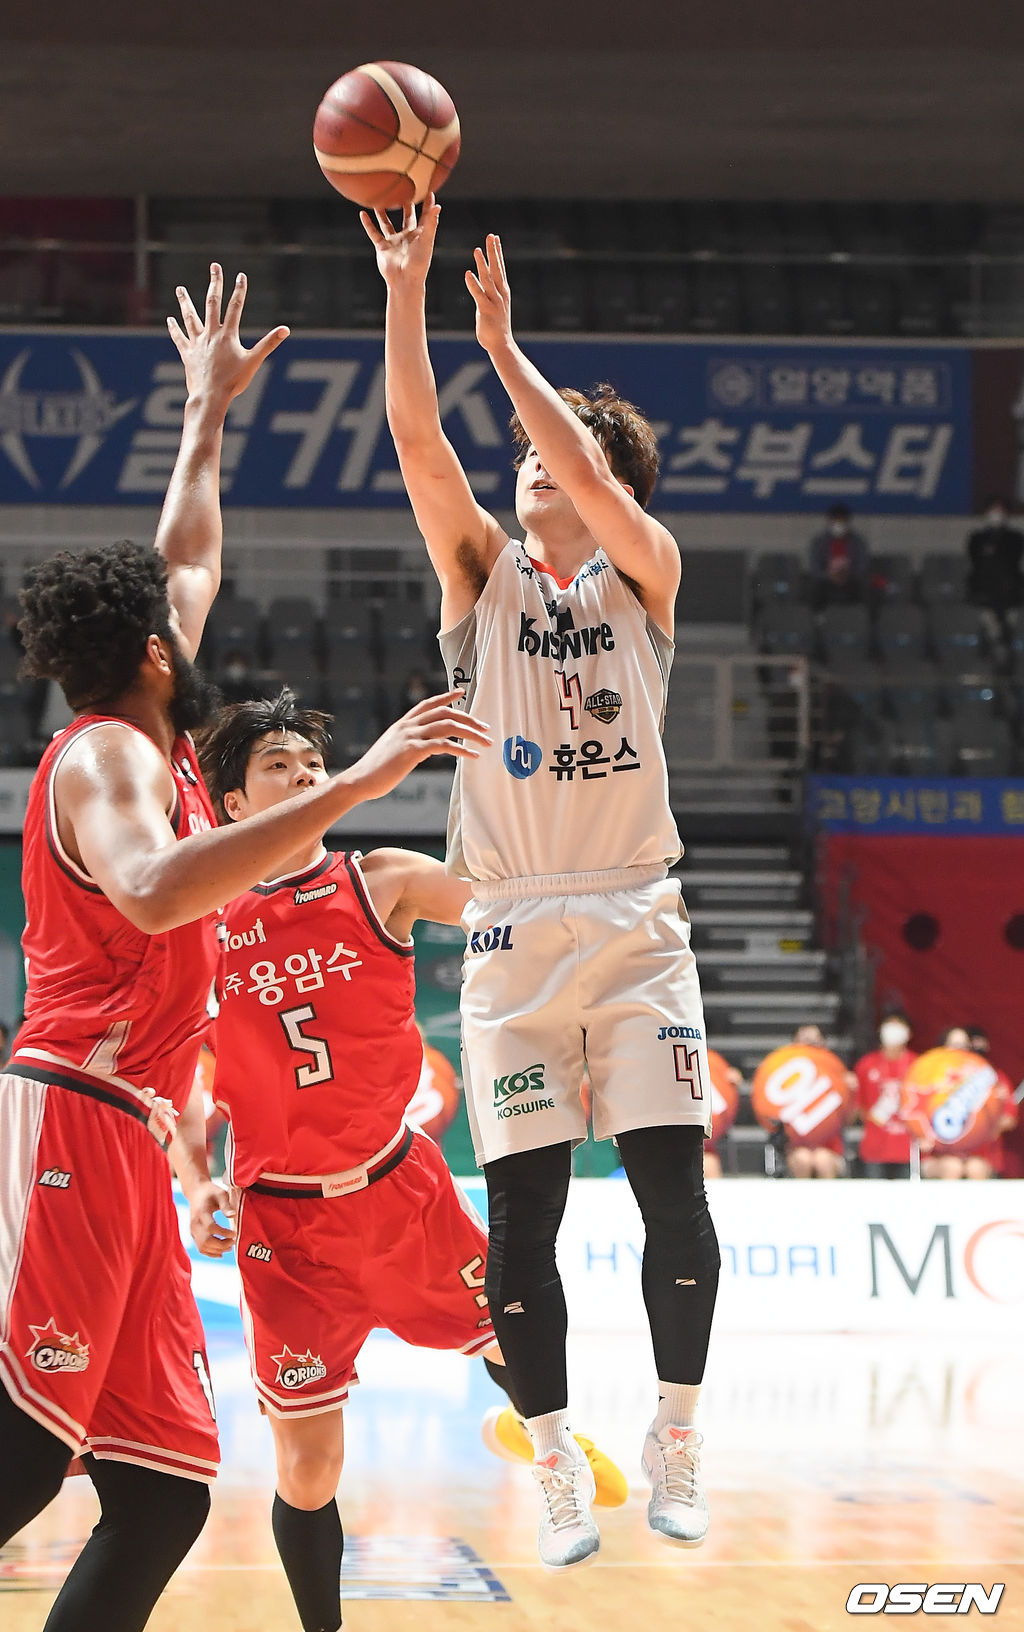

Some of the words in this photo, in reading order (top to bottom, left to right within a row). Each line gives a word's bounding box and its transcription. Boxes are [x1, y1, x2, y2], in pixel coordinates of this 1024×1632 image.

[652, 421, 955, 498] 츠부스터
[554, 669, 583, 731] 4
[549, 737, 641, 781] 휴온스
[817, 787, 983, 824] 고양시민과
[470, 924, 514, 954] KBL
[222, 942, 362, 1006] 주용암수
[278, 1002, 335, 1090] 5
[493, 1068, 546, 1101] KOS
[673, 1044, 704, 1101] 4
[497, 1098, 555, 1121] KOSWIRE
[38, 1169, 72, 1189] KBL
[247, 1243, 272, 1262] KBL
[283, 1365, 326, 1387] ORIONS
